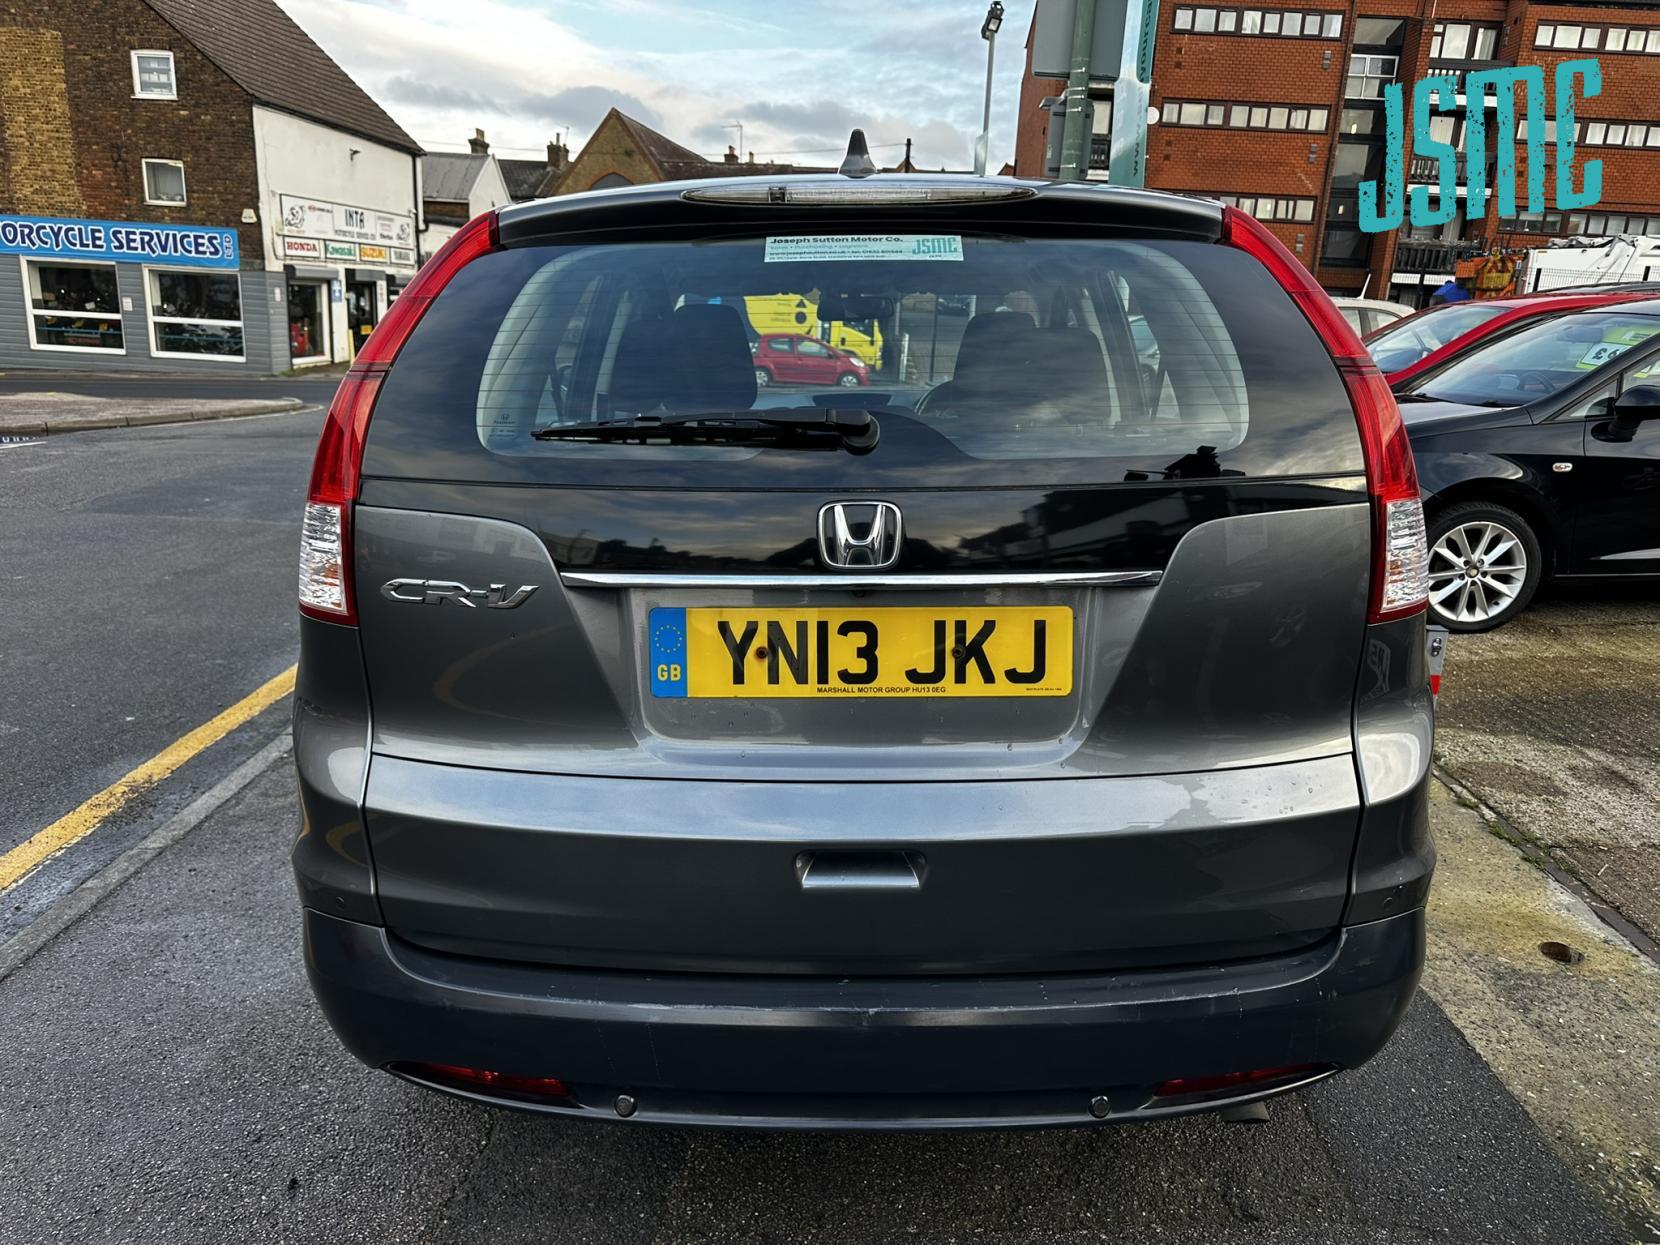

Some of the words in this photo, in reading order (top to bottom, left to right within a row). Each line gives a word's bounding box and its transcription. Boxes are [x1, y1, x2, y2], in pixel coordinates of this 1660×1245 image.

[345, 209, 365, 229] INTA
[0, 222, 105, 250] ORCYCLE
[110, 228, 223, 258] SERVICES
[286, 241, 318, 252] HONDA
[912, 237, 958, 255] JSMC
[380, 578, 539, 609] CR-V
[717, 620, 879, 685] YN13
[905, 620, 1047, 685] JKJ
[657, 664, 682, 681] GB
